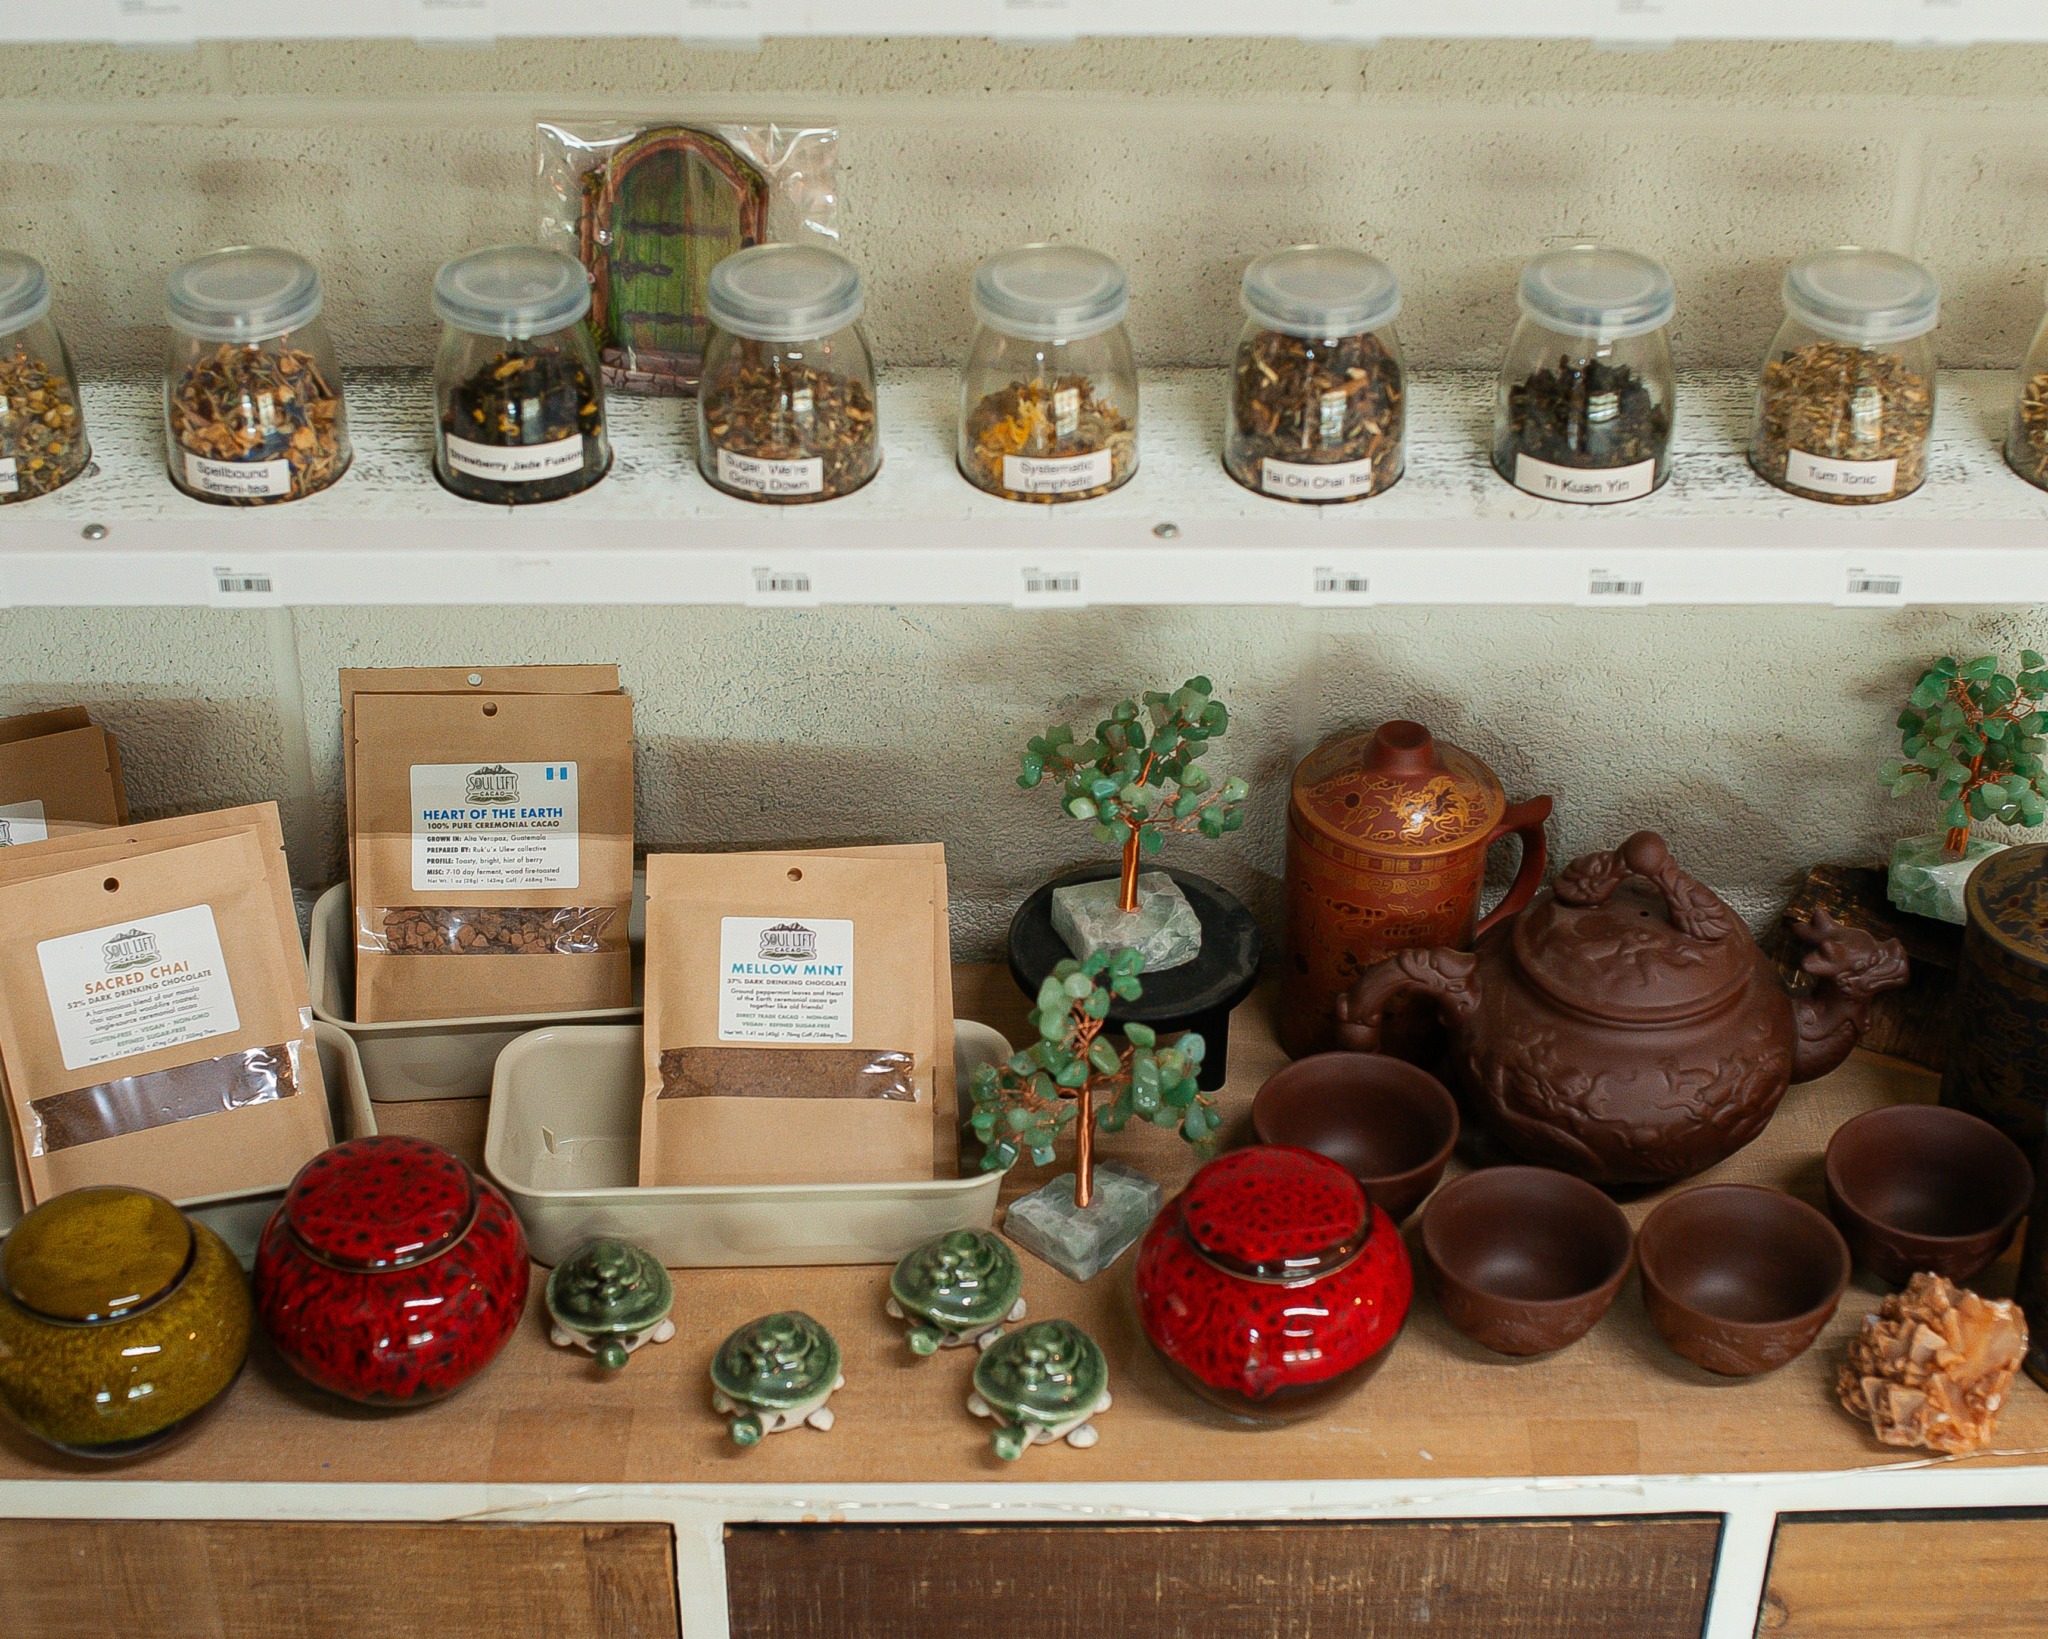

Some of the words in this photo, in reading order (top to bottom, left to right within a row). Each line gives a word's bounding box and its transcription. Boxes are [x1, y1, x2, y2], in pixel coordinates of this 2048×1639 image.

[197, 461, 269, 479] Spellbound
[1808, 466, 1837, 482] Tum
[1842, 472, 1877, 485] Tonic
[770, 479, 810, 491] Down
[1024, 475, 1094, 493] Lymphatic
[1285, 474, 1309, 487] Chi
[1311, 476, 1344, 489] Chai
[1350, 473, 1370, 485] Tea
[1545, 474, 1557, 489] Ti
[1561, 479, 1602, 493] Kuan
[1606, 479, 1630, 493] Yin
[469, 776, 494, 790] SOUL
[496, 775, 515, 790] LIFT
[423, 809, 465, 820] HEART
[470, 809, 488, 820] OF
[492, 808, 516, 819] THE
[521, 807, 562, 818] EARTH
[475, 821, 528, 829] CEREMONIAL
[531, 820, 560, 828] CACAO
[464, 834, 477, 842] Alta
[479, 835, 509, 843] Verapaz,
[480, 857, 501, 865] bright,
[525, 856, 543, 864] berry
[462, 868, 475, 876] day
[476, 867, 503, 876] ferment,
[524, 866, 560, 874] fire-toasted
[763, 932, 791, 947] SOUL
[792, 933, 813, 947] LIFT
[105, 941, 133, 961] SOUL
[132, 936, 153, 953] LIFT
[119, 953, 146, 963] CACAO
[731, 963, 798, 975] MELLOW
[803, 964, 844, 976] MINT
[84, 971, 145, 995] SACRED
[150, 960, 189, 979] CHAI
[67, 1000, 86, 1009] 52%
[88, 993, 113, 1005] DARK
[114, 982, 159, 998] DRINKING
[161, 969, 212, 987] CHOCOLATE
[133, 996, 152, 1007] blend
[154, 993, 161, 1001] of
[175, 985, 200, 996] masala
[139, 1006, 176, 1020] ceremonial
[177, 1003, 198, 1012] cacao
[750, 1002, 776, 1010] together
[105, 1013, 123, 1022] spice
[124, 1008, 138, 1017] and
[140, 1023, 165, 1033] VEGAN
[173, 1012, 210, 1025] NON-GMO
